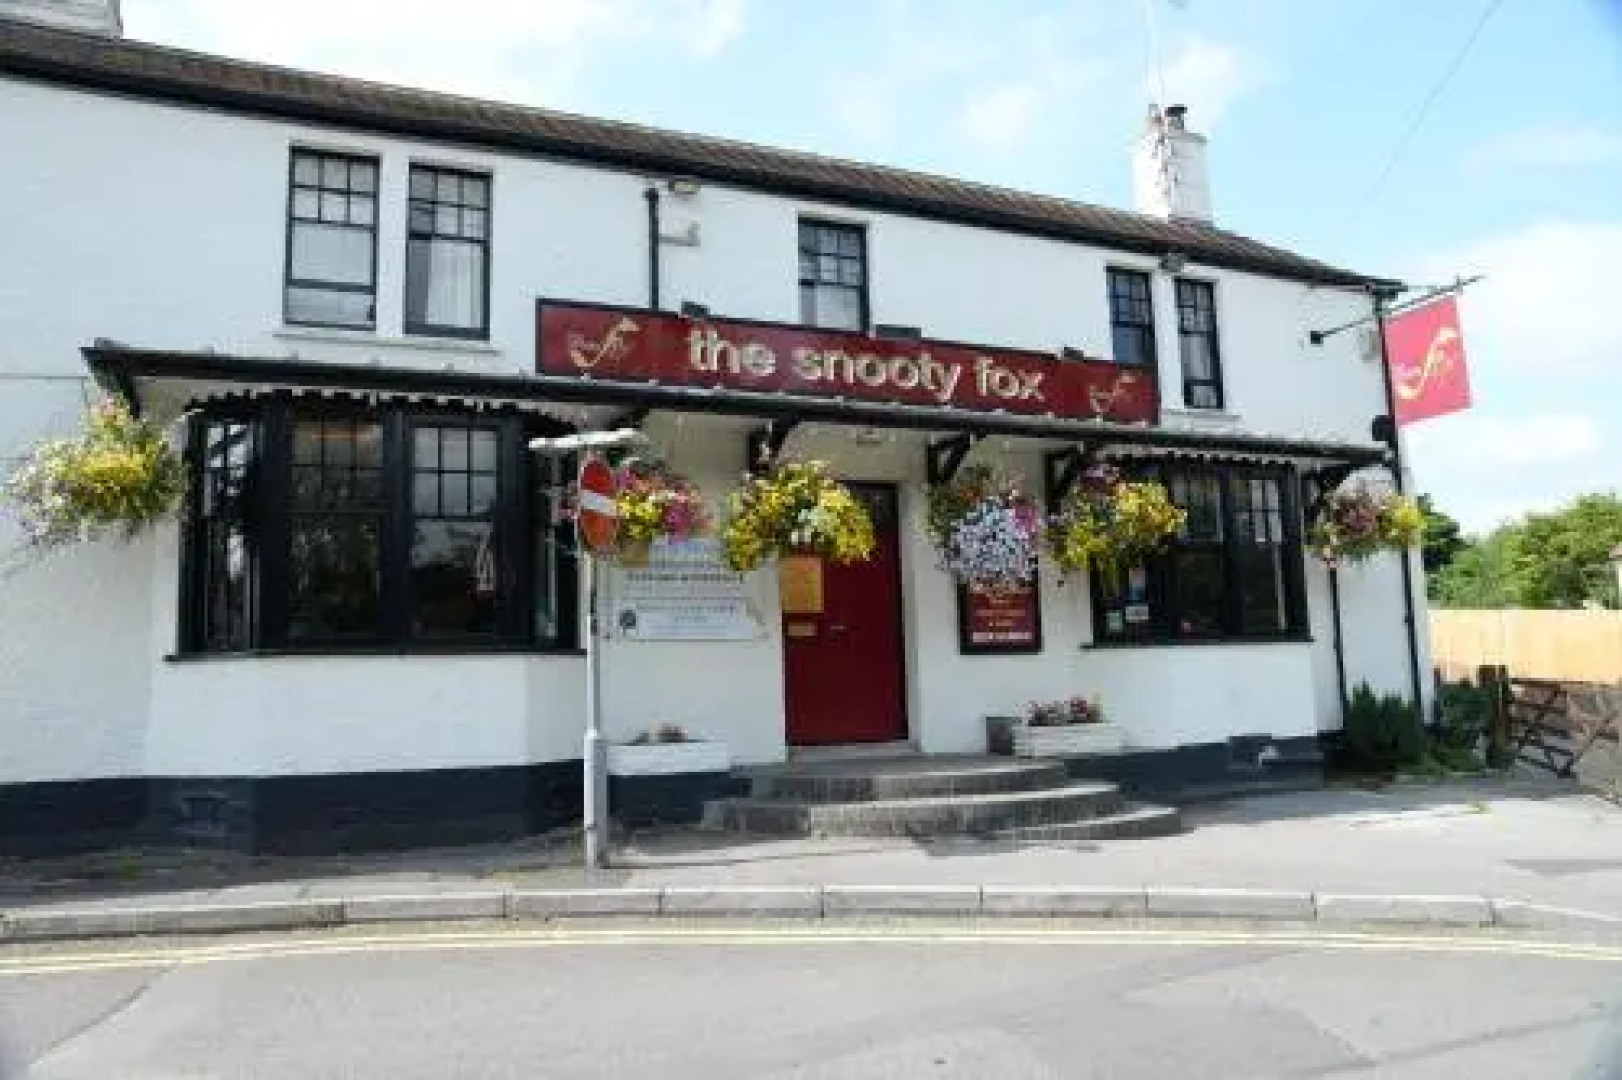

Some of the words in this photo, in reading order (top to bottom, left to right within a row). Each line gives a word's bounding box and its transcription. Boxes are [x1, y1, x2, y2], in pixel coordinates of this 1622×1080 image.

[688, 328, 776, 377] the
[792, 348, 961, 401] snooty
[975, 356, 1044, 400] fox
